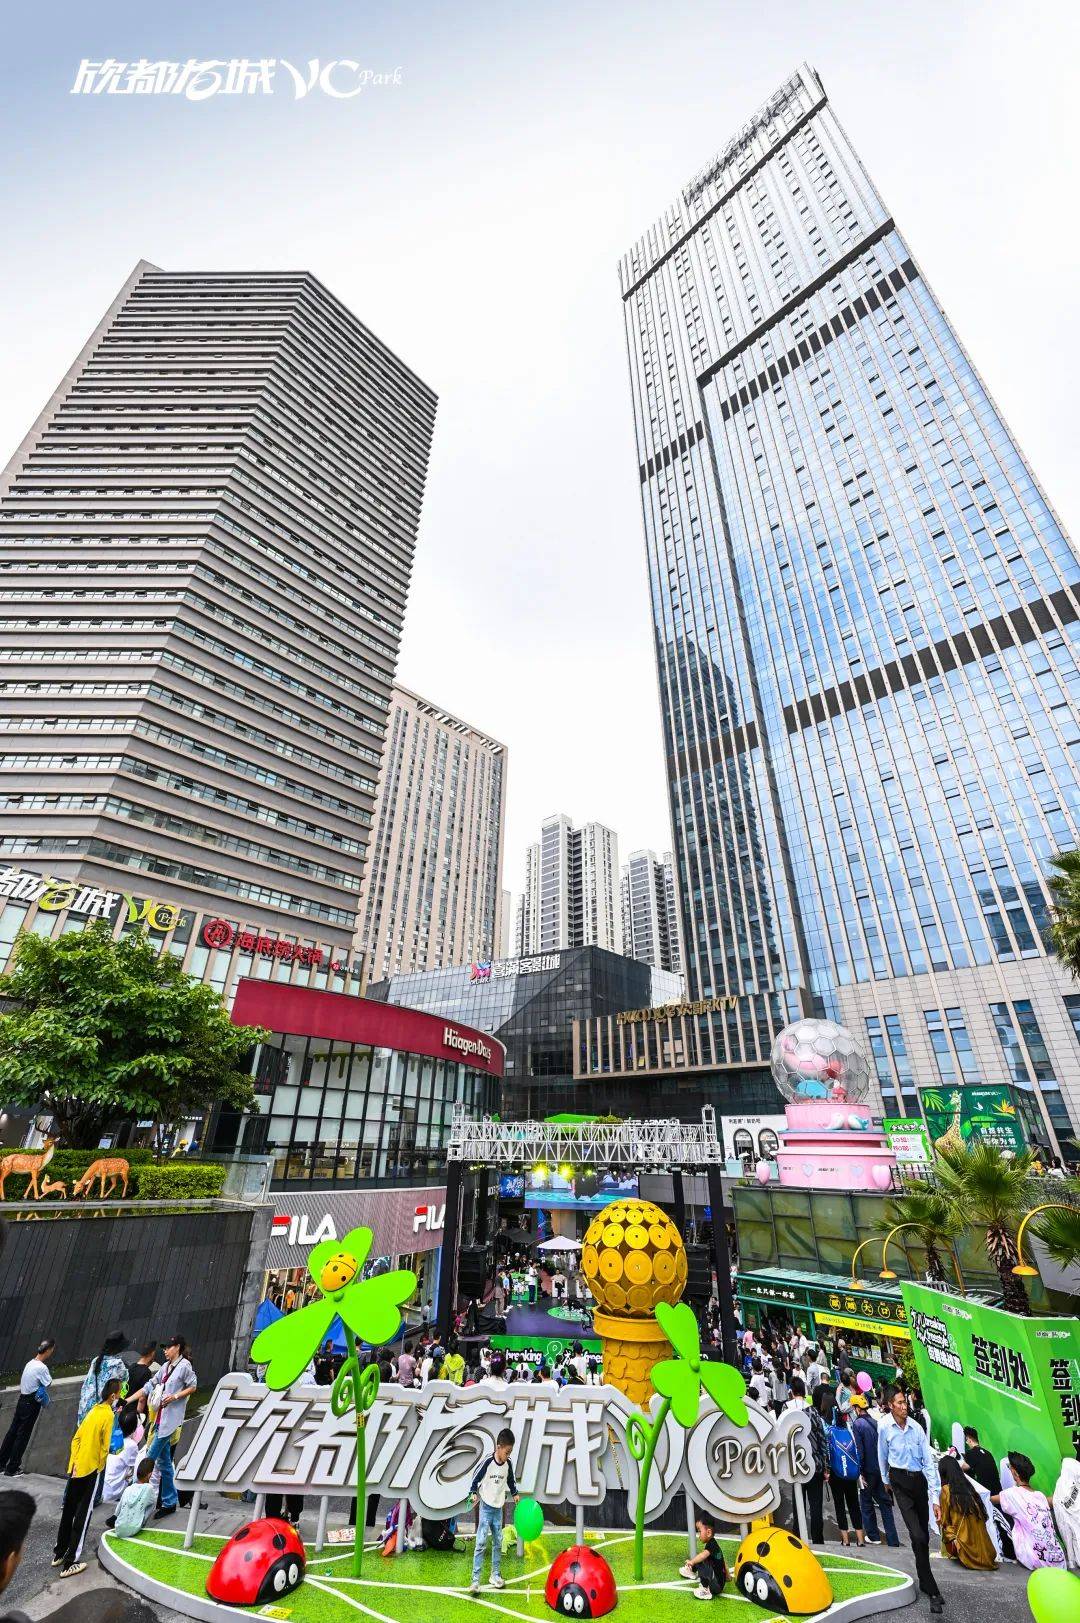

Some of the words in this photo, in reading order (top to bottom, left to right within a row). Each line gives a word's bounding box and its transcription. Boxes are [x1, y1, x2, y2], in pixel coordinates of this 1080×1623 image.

[271, 1214, 337, 1246] FILA
[971, 1332, 1034, 1396] 签到处
[714, 1423, 811, 1478] Park
